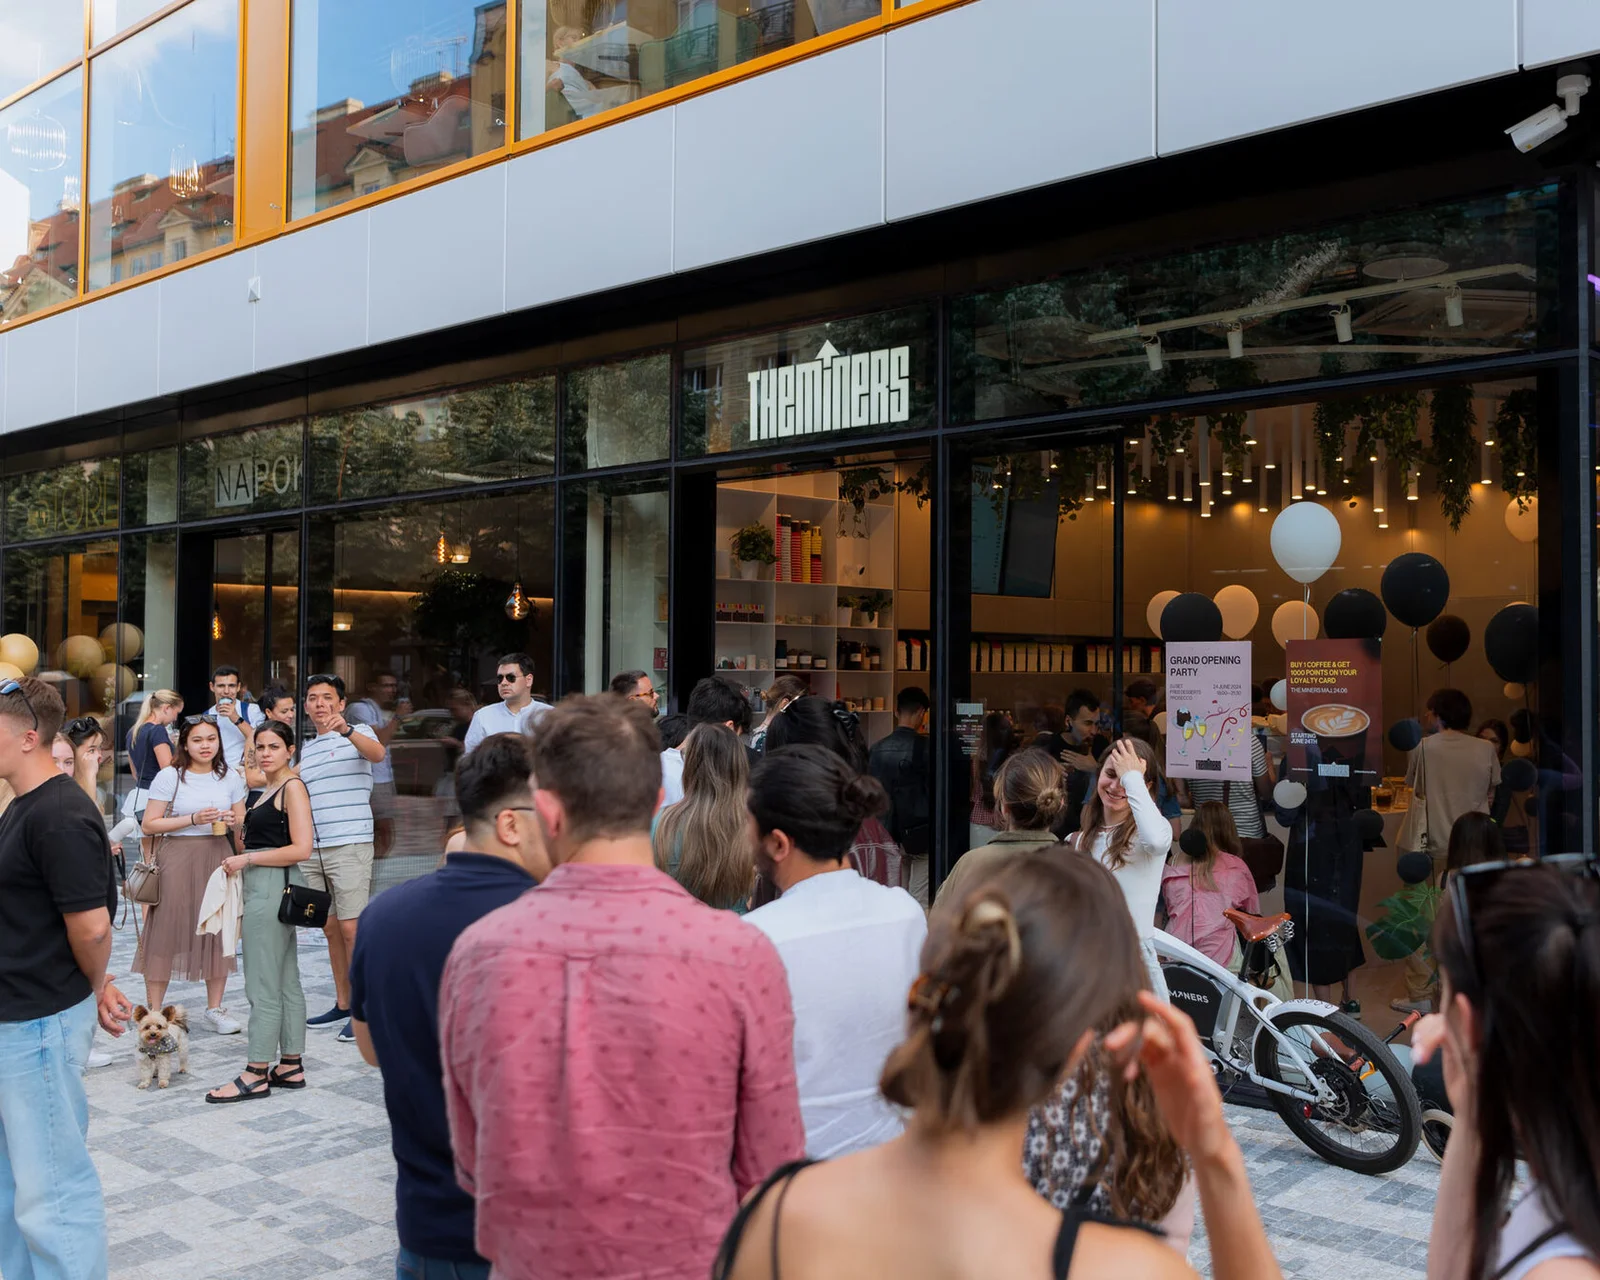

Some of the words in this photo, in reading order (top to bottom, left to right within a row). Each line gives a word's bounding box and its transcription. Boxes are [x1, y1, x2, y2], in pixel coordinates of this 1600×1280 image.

[1170, 655, 1200, 665] GRAND
[1201, 655, 1241, 665] OPENING
[1170, 668, 1198, 676] PARTY
